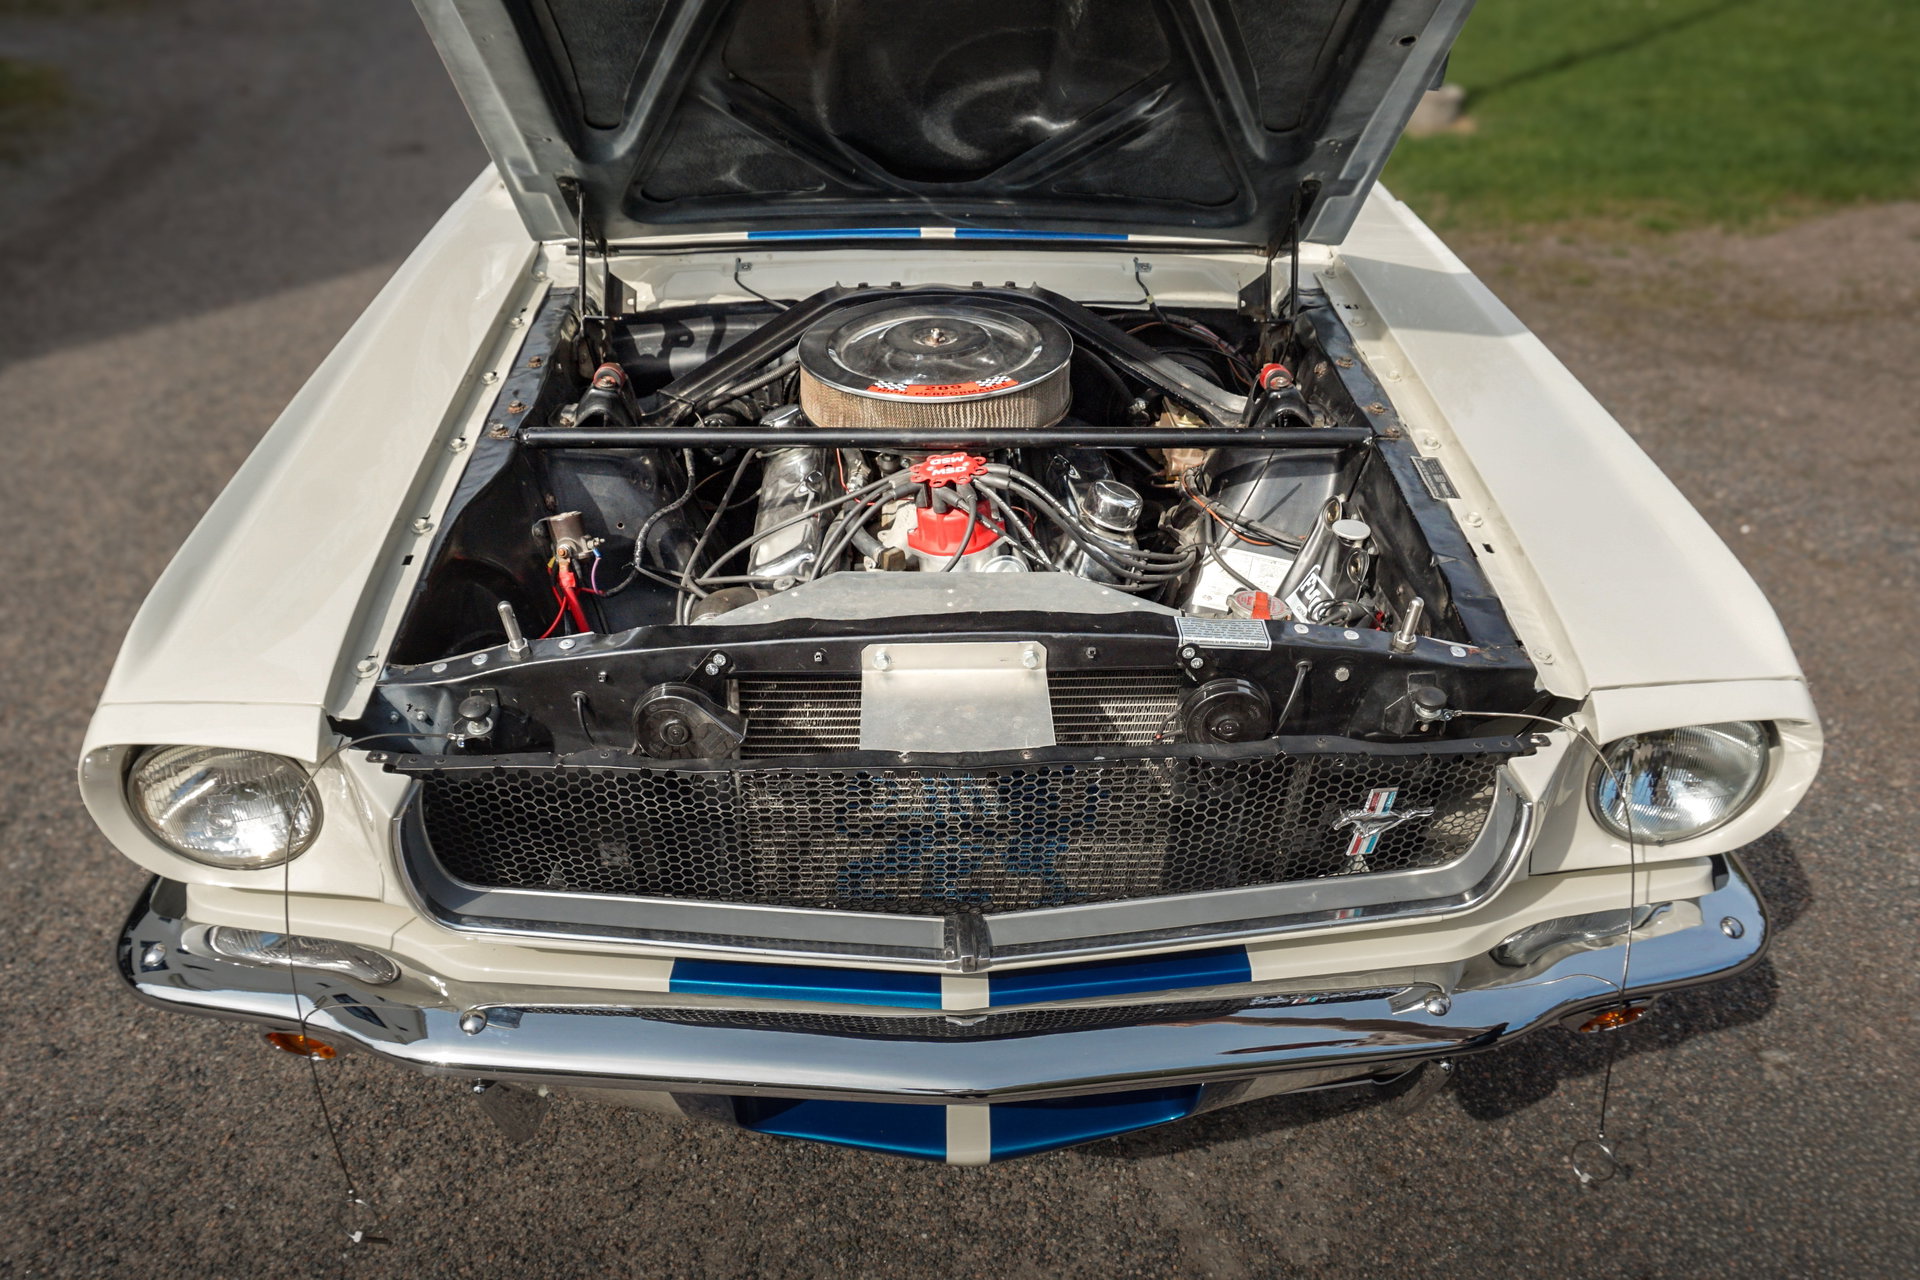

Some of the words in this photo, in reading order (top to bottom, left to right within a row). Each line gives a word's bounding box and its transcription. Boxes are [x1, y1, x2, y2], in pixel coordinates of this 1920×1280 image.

[915, 383, 1008, 396] PERFORMANCE
[930, 456, 964, 465] MSD
[931, 466, 967, 476] MSD
